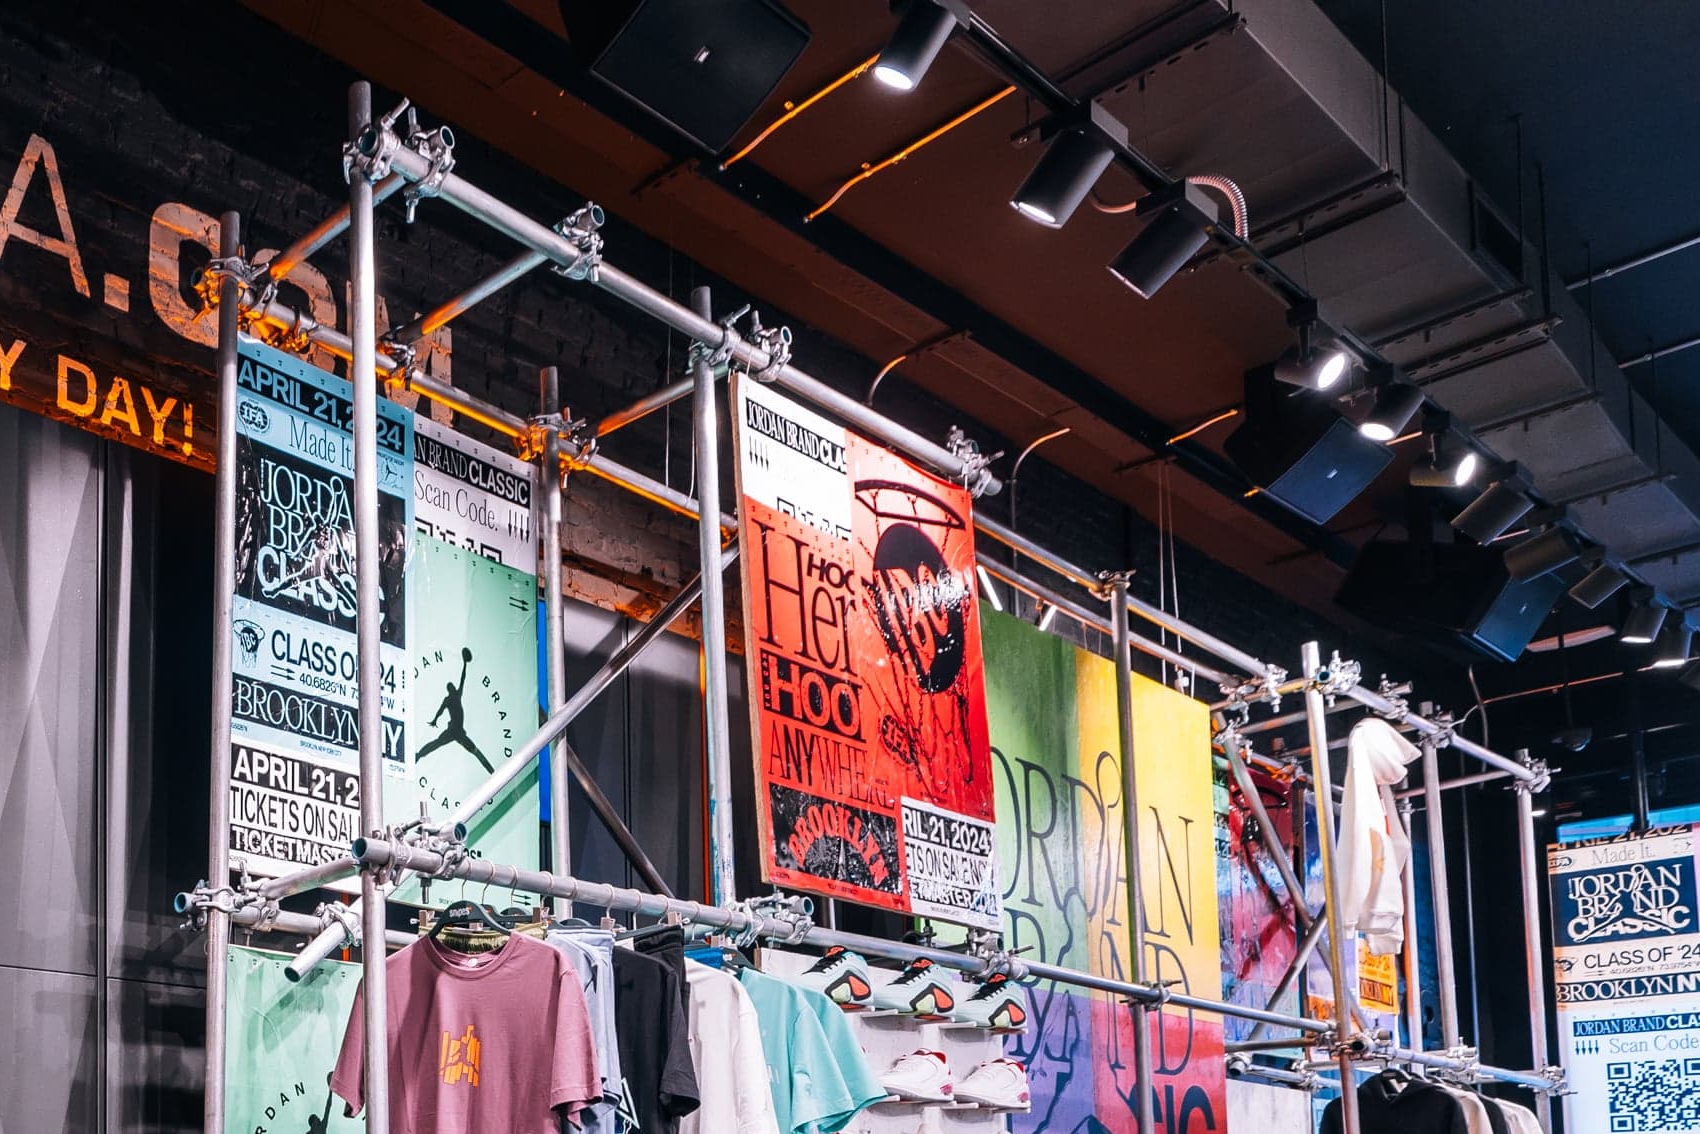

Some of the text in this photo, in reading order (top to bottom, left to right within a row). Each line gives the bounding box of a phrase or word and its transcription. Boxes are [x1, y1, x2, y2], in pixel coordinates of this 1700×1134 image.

[57, 354, 195, 456] DAY!
[238, 359, 310, 413] APRIL
[314, 391, 342, 427] 21,
[289, 414, 336, 464] Made
[748, 401, 785, 444] JORDAN
[786, 417, 820, 459] BRAND
[429, 442, 468, 480] BRAND
[468, 459, 528, 505] CLASSIC
[415, 470, 499, 532] Scan Code.
[272, 629, 337, 677] CLASS
[235, 678, 360, 746] BROOKLYN
[482, 675, 513, 758] BRAND
[233, 748, 309, 795] APRIL
[311, 768, 341, 805] 21,
[230, 785, 299, 833] TICKETS
[303, 802, 325, 839] ON
[789, 803, 890, 887] BROOKLYN
[1591, 848, 1635, 866] Made
[1568, 863, 1683, 899] JORDAN
[1567, 905, 1691, 941] CLASSIC
[1584, 950, 1644, 969] CLASS
[1648, 946, 1674, 963] OF
[1559, 975, 1676, 1002] BROOKLYN
[1575, 1019, 1622, 1036] JORDAN
[1623, 1016, 1665, 1034] BRAND
[1609, 1038, 1648, 1054] Scan
